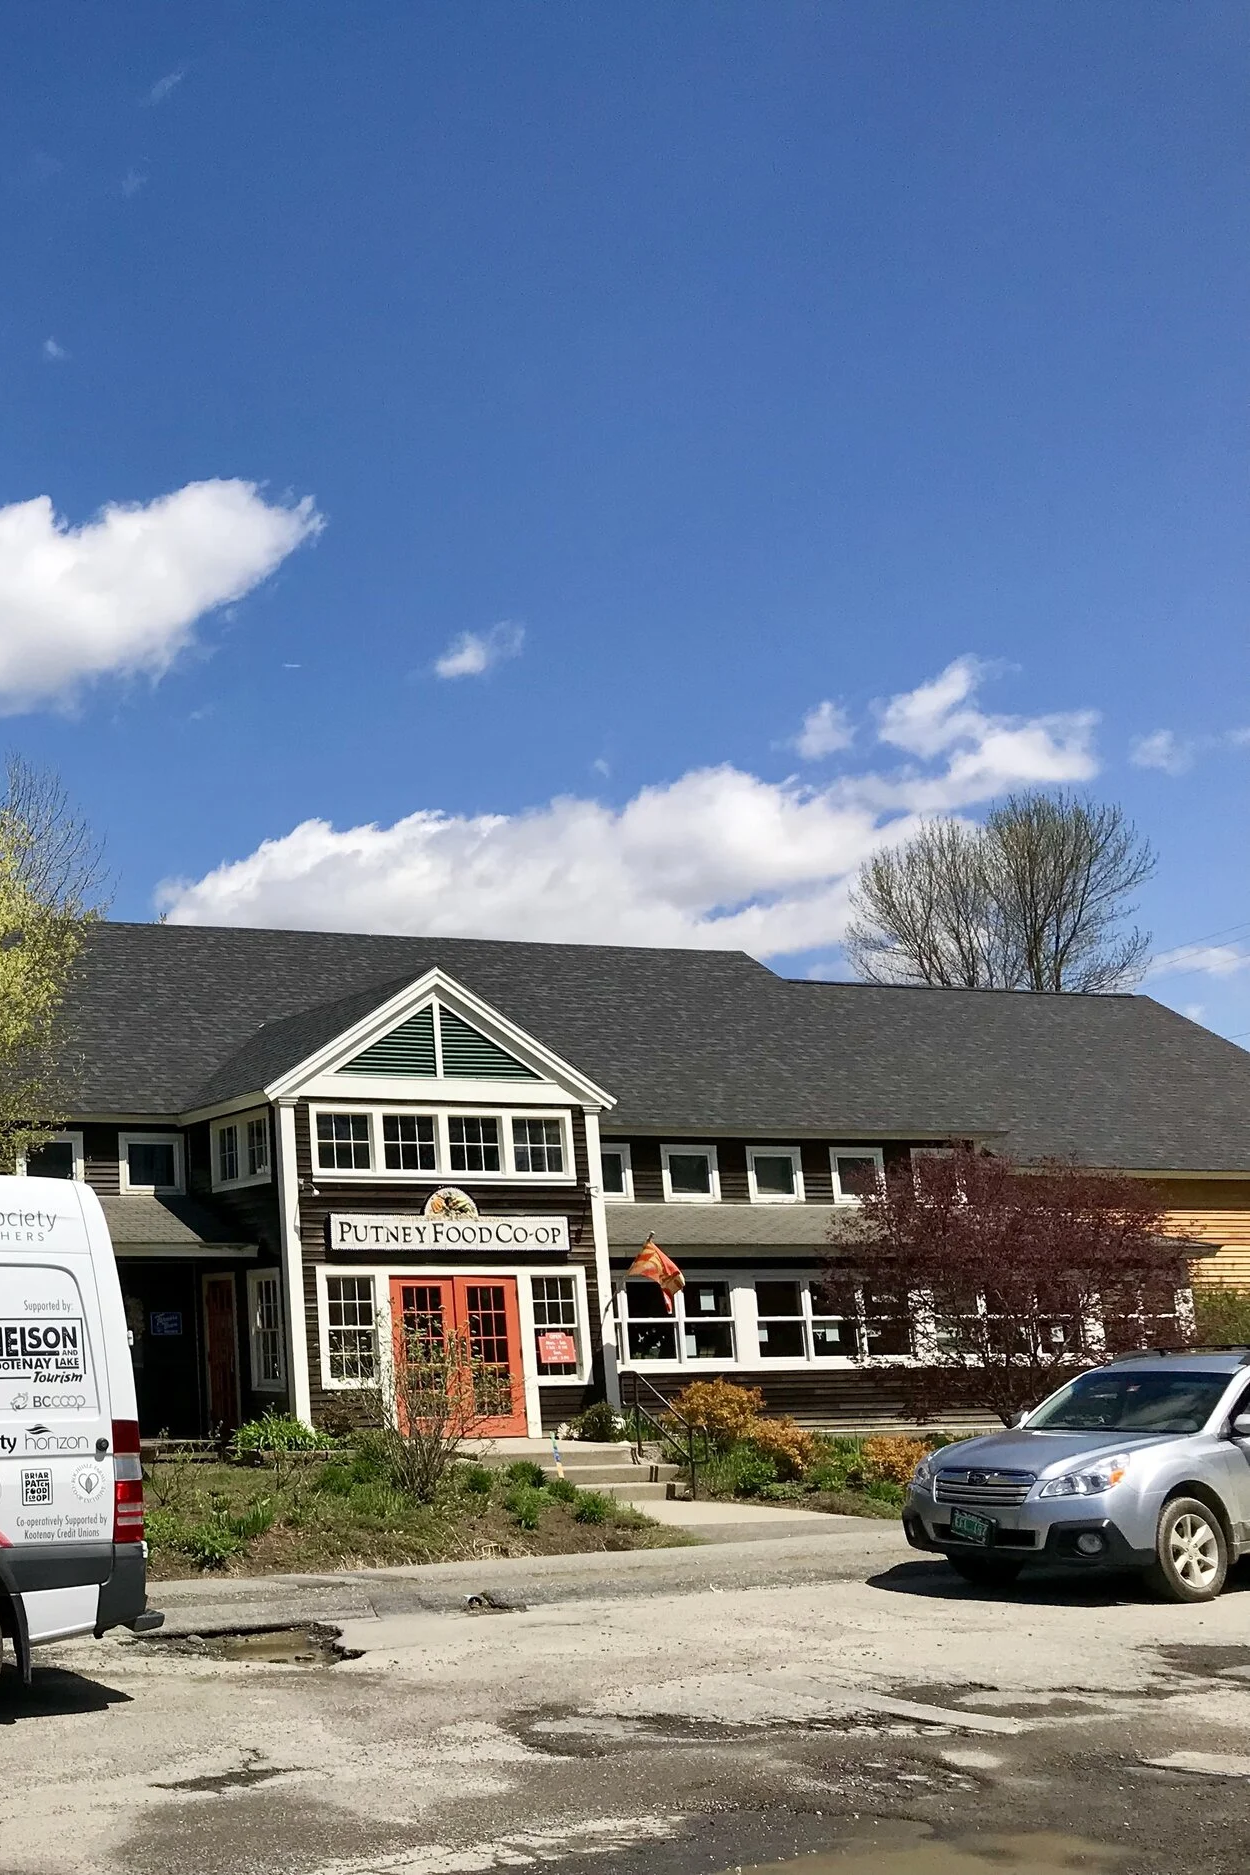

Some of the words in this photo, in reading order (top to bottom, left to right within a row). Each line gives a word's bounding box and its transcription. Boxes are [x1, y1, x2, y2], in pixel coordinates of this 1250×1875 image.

[339, 1221, 427, 1243] PUTNEY
[432, 1223, 492, 1243] FOOD
[495, 1223, 561, 1243] CO-OP
[24, 1299, 60, 1313] Supported
[55, 1358, 79, 1369] LAKE
[33, 1371, 83, 1383] Tourism
[25, 1433, 88, 1450] horizon
[16, 1514, 63, 1528] Co-operatively
[65, 1513, 97, 1527] Supported
[99, 1513, 108, 1526] by
[24, 1529, 55, 1540] Kootenay
[57, 1528, 76, 1538] Credit
[78, 1527, 100, 1538] Unions
